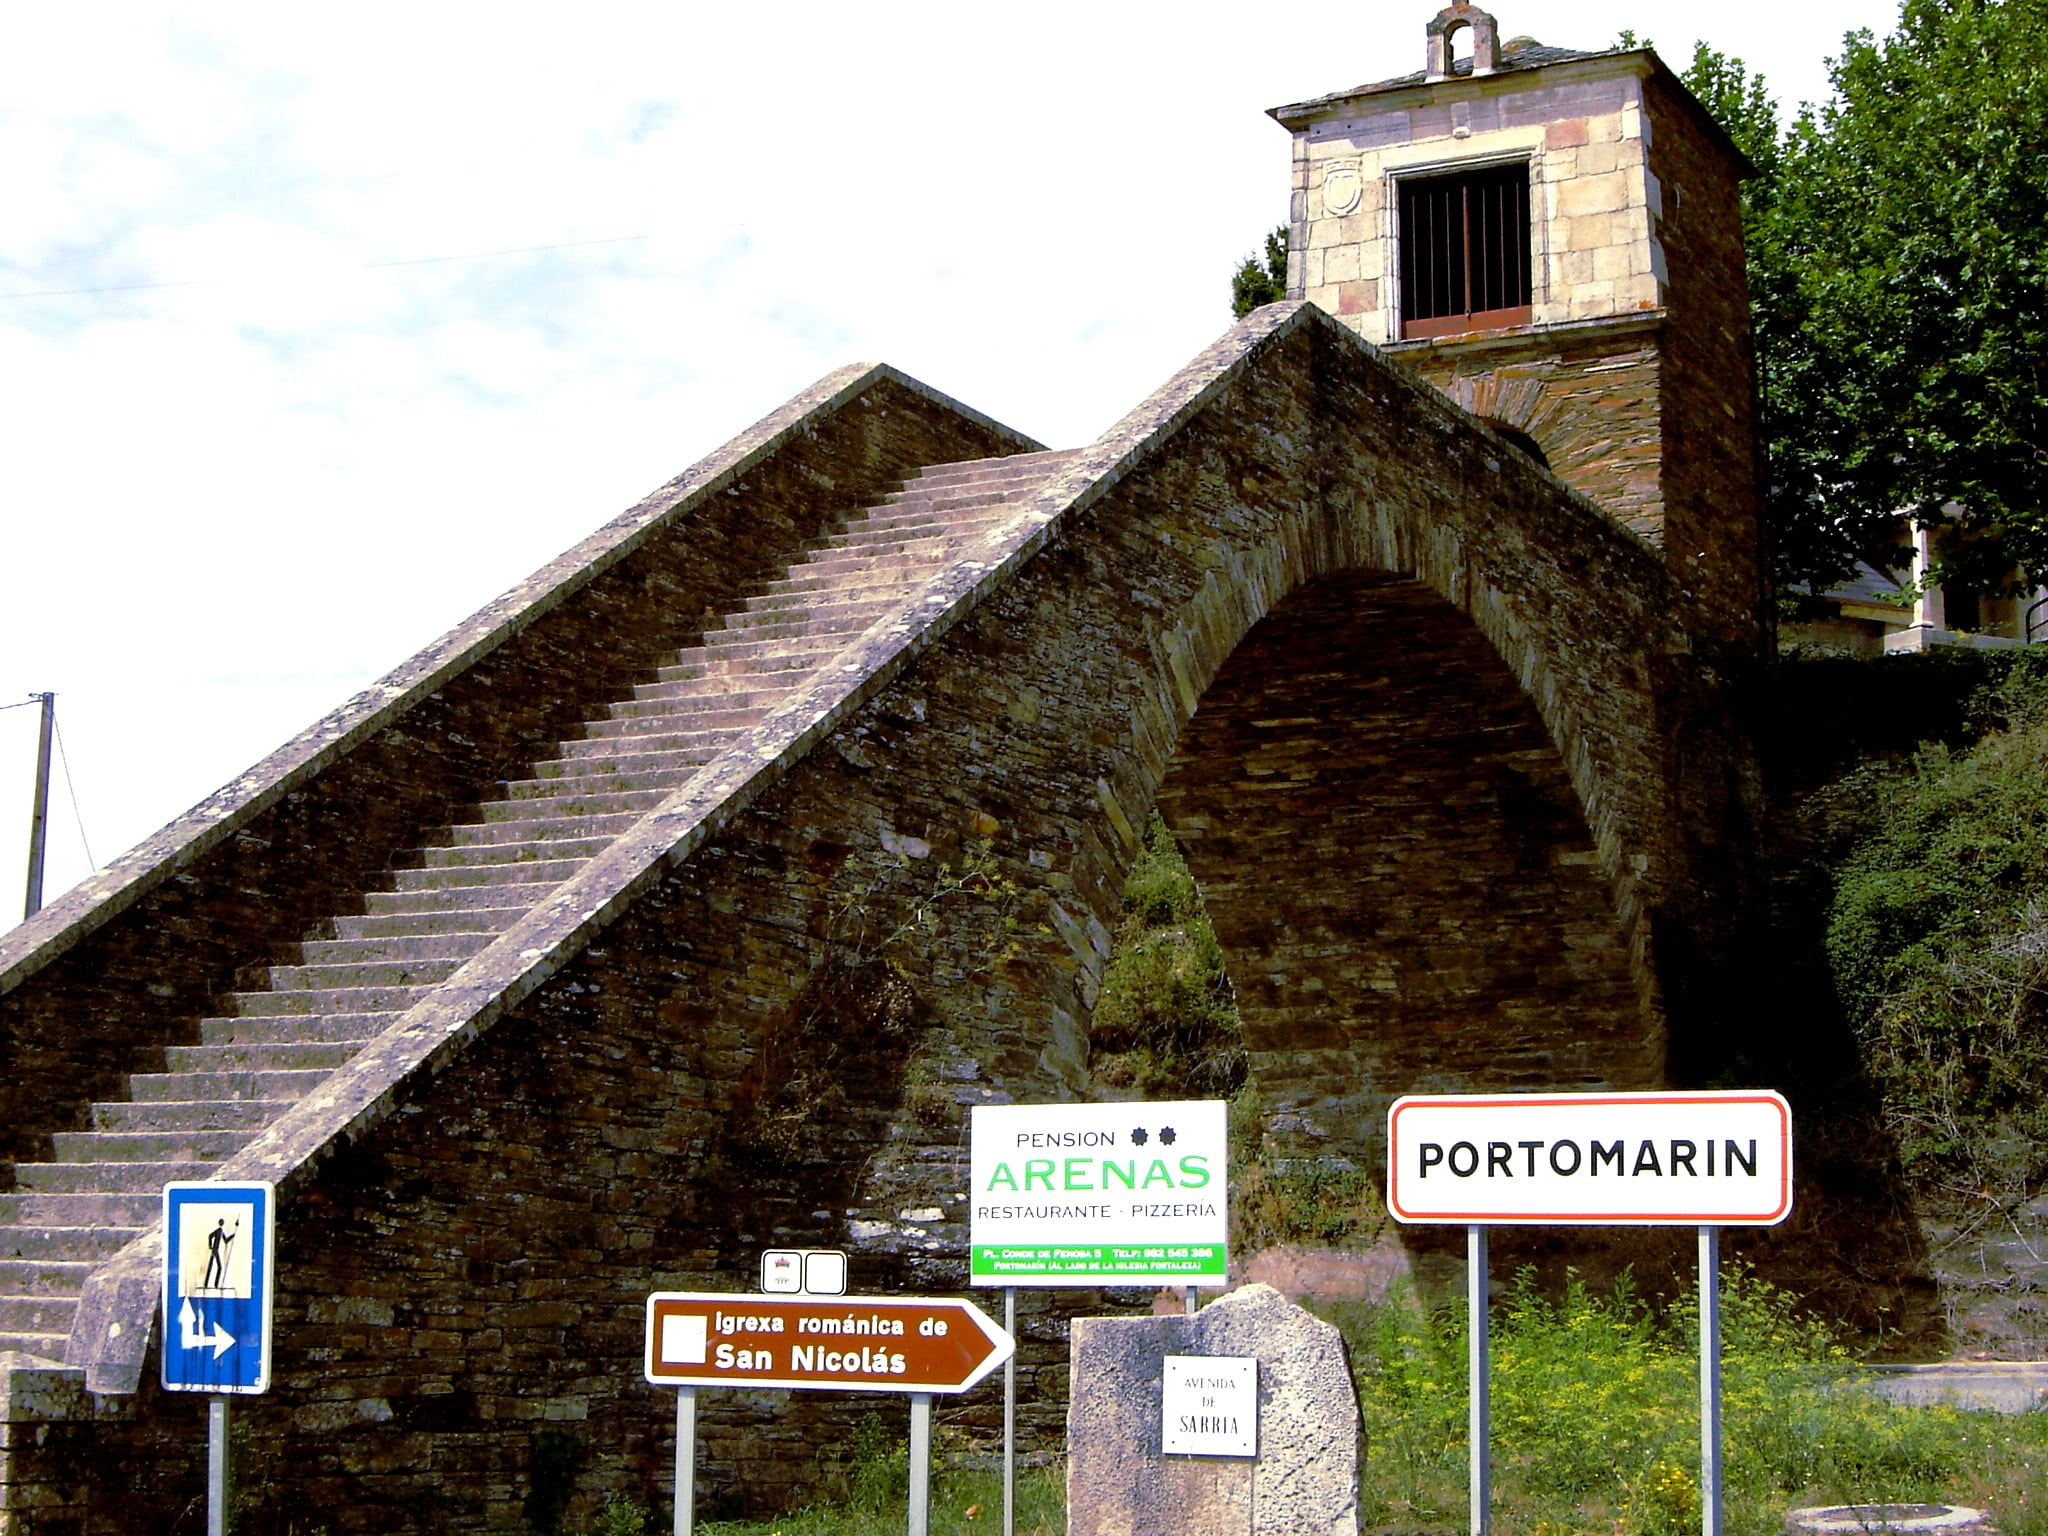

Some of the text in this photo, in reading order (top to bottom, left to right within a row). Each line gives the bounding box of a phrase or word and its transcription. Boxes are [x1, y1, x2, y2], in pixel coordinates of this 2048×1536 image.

[1016, 1131, 1116, 1148] PENSION
[1419, 1138, 1758, 1179] PORTOMARIN
[986, 1154, 1212, 1192] ARENAS
[977, 1205, 1113, 1219] RESTAURANTE
[798, 1313, 905, 1335] románica
[918, 1316, 948, 1336] de
[714, 1343, 907, 1374] San Nicolás
[1184, 1377, 1236, 1389] AVENIDA
[1202, 1396, 1217, 1408] DE
[1179, 1415, 1238, 1435] SARRIA
